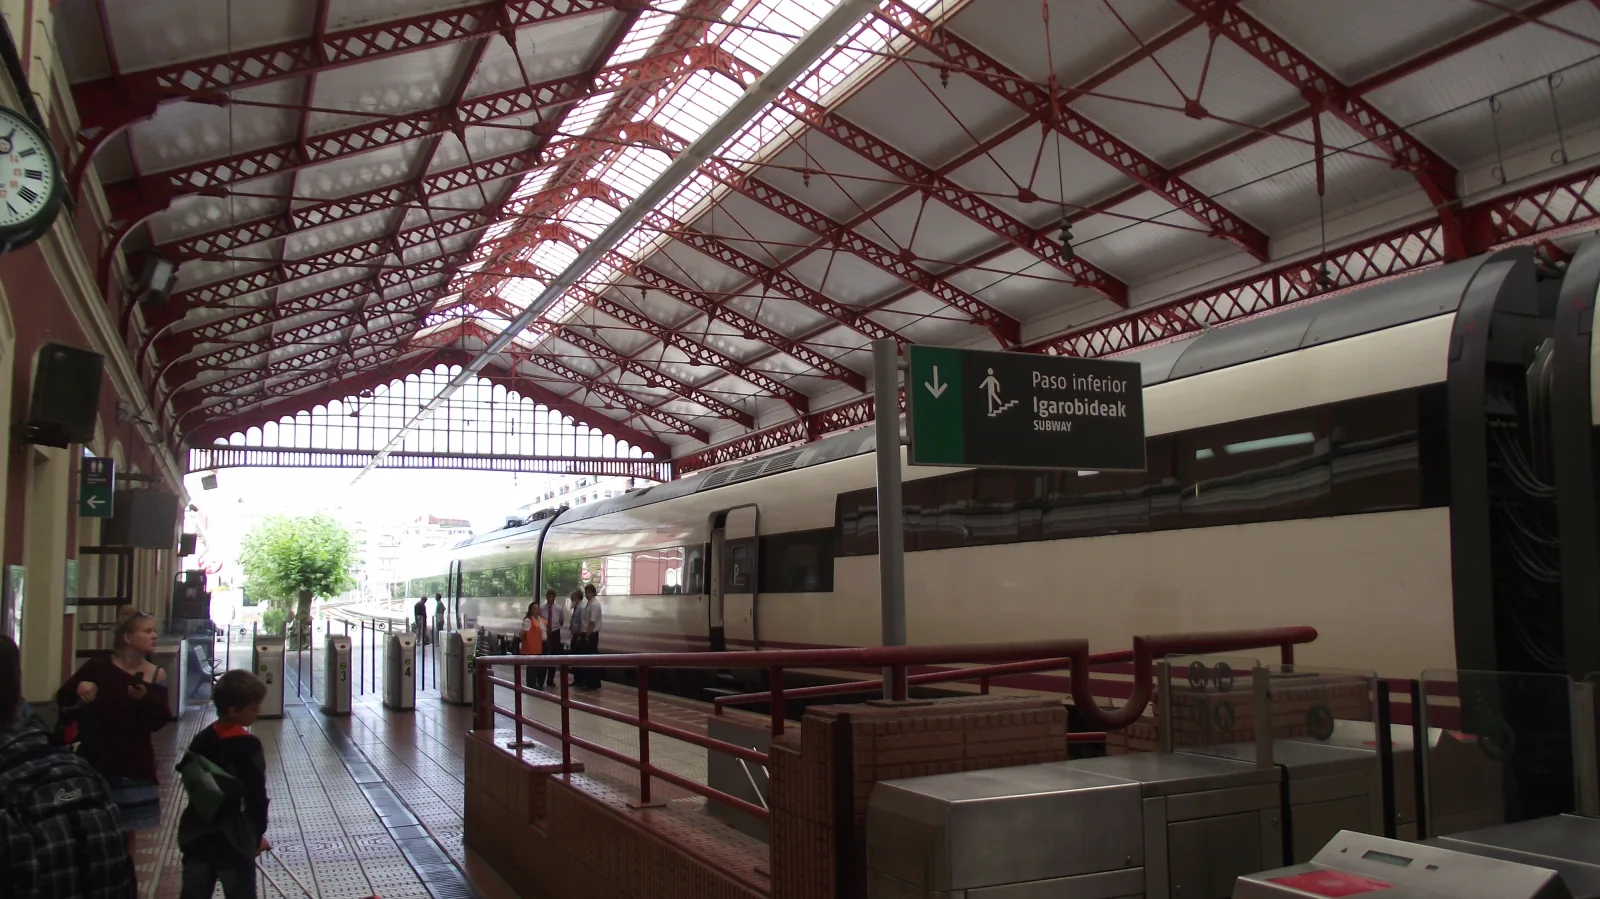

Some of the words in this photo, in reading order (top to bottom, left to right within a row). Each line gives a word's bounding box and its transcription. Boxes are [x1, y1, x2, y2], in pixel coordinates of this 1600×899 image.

[1032, 370, 1067, 390] Paso
[1072, 373, 1127, 393] inferior
[1033, 395, 1127, 418] Igarobideak
[1033, 419, 1072, 432] SUBWAY
[340, 671, 347, 682] 3
[404, 666, 411, 677] 4
